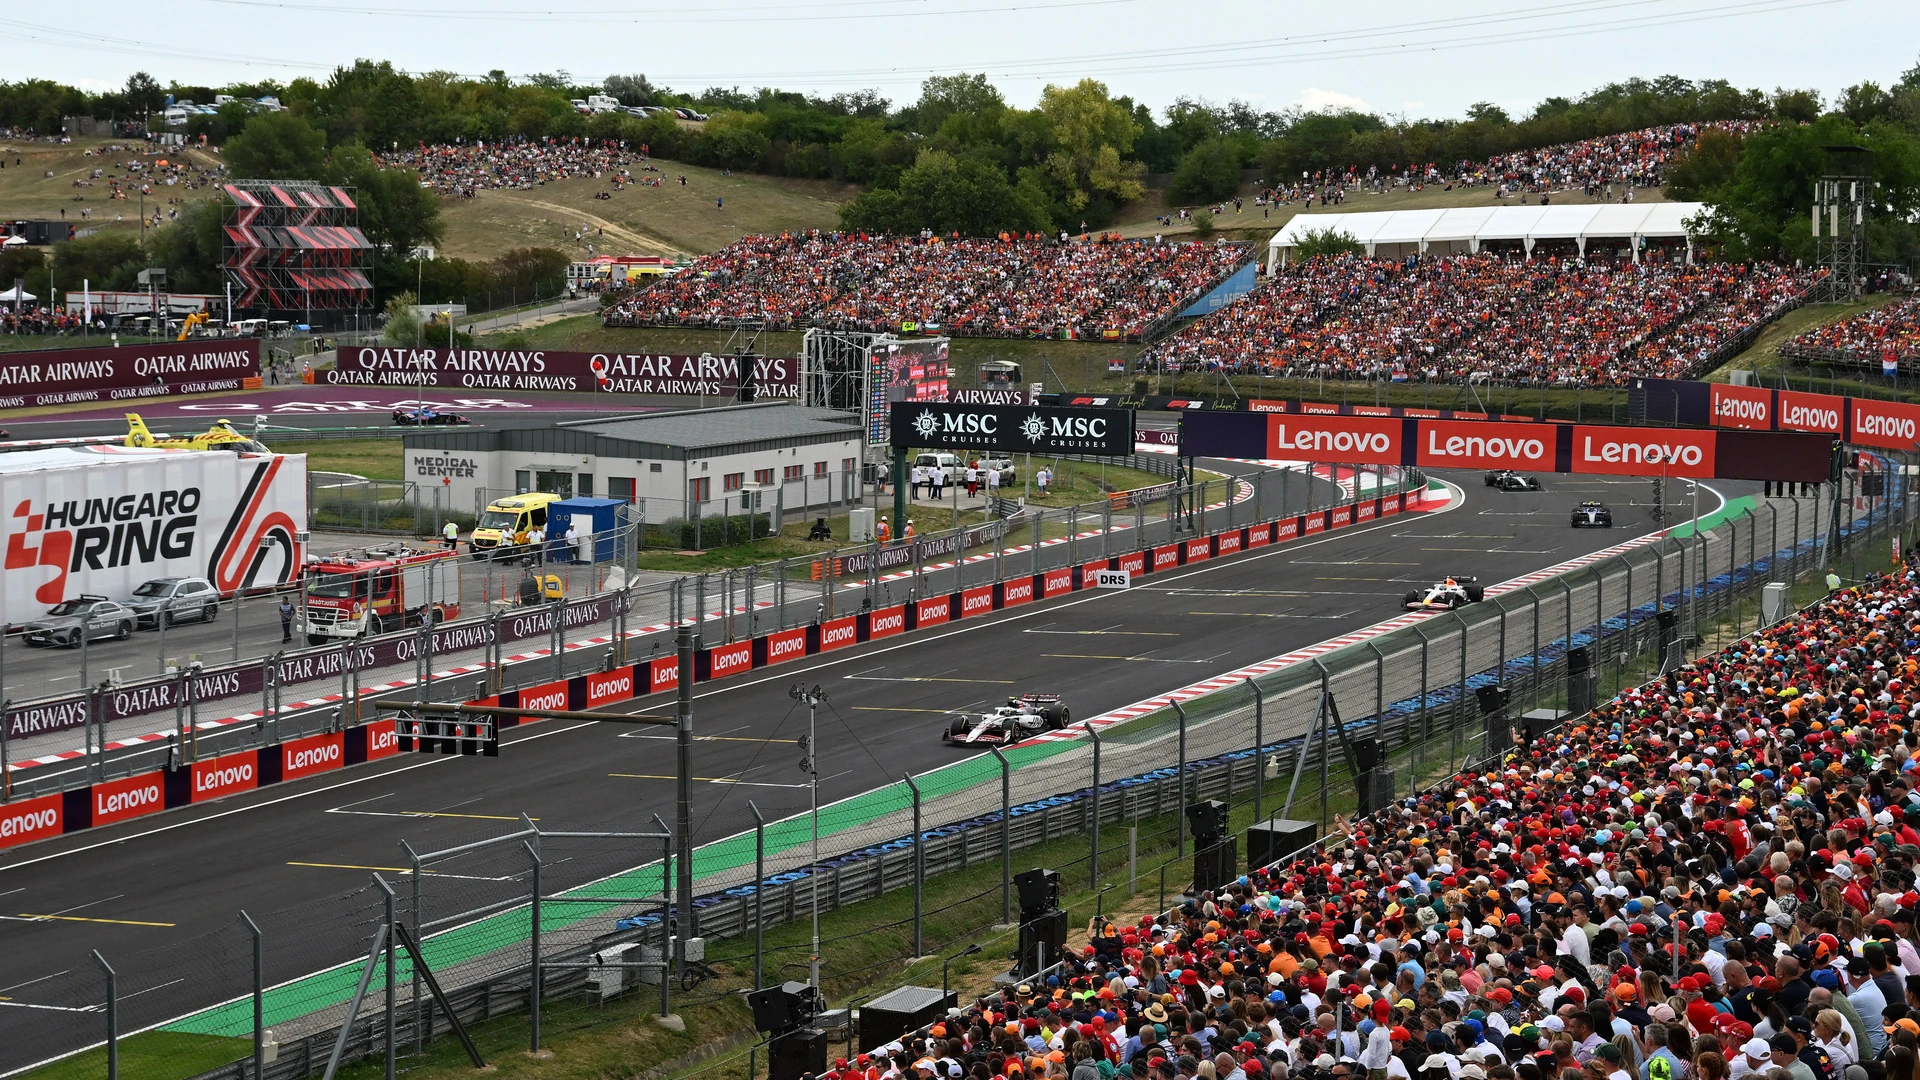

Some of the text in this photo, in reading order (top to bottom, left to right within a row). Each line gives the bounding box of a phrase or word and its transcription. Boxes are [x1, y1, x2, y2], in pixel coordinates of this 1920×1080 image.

[134, 350, 250, 376] QATAR AIRWAYS
[359, 348, 545, 372] QATAR AIRWAYS
[590, 354, 673, 378] QATAR
[0, 359, 114, 385] ATAR AIRWAYS
[327, 370, 438, 385] QATAR AIRWAYS
[181, 380, 238, 394] QATAR AIRWAYS
[462, 373, 577, 390] QATAR AIRWAYS
[602, 378, 720, 395] QATAR AIRWAYS
[37, 391, 99, 405] QATAR AIRWAYS
[111, 385, 170, 400] QATAR AIRWAYS
[954, 390, 1022, 405] AIRWAYS
[0, 396, 24, 408] WAYS
[1251, 402, 1284, 412] Lenovo
[1715, 392, 1766, 421] Lenovo
[943, 412, 997, 434] MSC
[1783, 400, 1838, 429] Lenovo
[1051, 416, 1106, 438] MSC
[1856, 408, 1915, 439] Lenovo
[942, 435, 997, 444] CRUISES
[1051, 440, 1106, 448] CRUISES
[1160, 432, 1178, 444] QAT
[1279, 424, 1390, 453] Lenovo
[1429, 430, 1544, 459] Lenovo
[1584, 436, 1703, 466] Lenovo
[414, 456, 478, 468] MEDICAL
[418, 466, 474, 478] CENTER
[45, 487, 200, 530] HUNGARO
[1358, 505, 1375, 518] Lenovo
[1382, 499, 1399, 512] Lenovo
[1306, 517, 1324, 530] Lenovo
[1333, 511, 1350, 524] Lenovo
[1250, 530, 1269, 543] Lenovo
[1279, 523, 1297, 537] Lenovo
[70, 514, 198, 573] RING
[1188, 543, 1209, 558] Lenovo
[1220, 536, 1240, 550] Lenovo
[1120, 559, 1142, 572] Lenovo
[1155, 551, 1177, 565] Lenovo
[1046, 575, 1070, 591] Lenovo
[1084, 567, 1107, 582] Len
[1100, 575, 1126, 585] DRS
[1006, 585, 1031, 600] Lenovo
[964, 594, 990, 611] Lenovo
[514, 603, 599, 637] QATAR AIRWAYS
[919, 604, 948, 621] Lenovo
[872, 614, 902, 632] Lenovo
[396, 623, 495, 660] QAR AIRWAYS
[823, 625, 854, 644] Lenovo
[770, 637, 803, 657] Lenovo
[714, 649, 749, 671] Lenovo
[654, 663, 678, 684] Leno
[590, 677, 630, 699] Lenovo
[115, 685, 170, 716] QATAR
[523, 692, 565, 710] Lenovo
[11, 701, 86, 735] AIRWAYS
[372, 724, 419, 750] Leno
[287, 743, 339, 771] Lenovo
[196, 763, 253, 792] Lenovo
[98, 785, 159, 815] Lenovo
[0, 808, 57, 839] enovo
